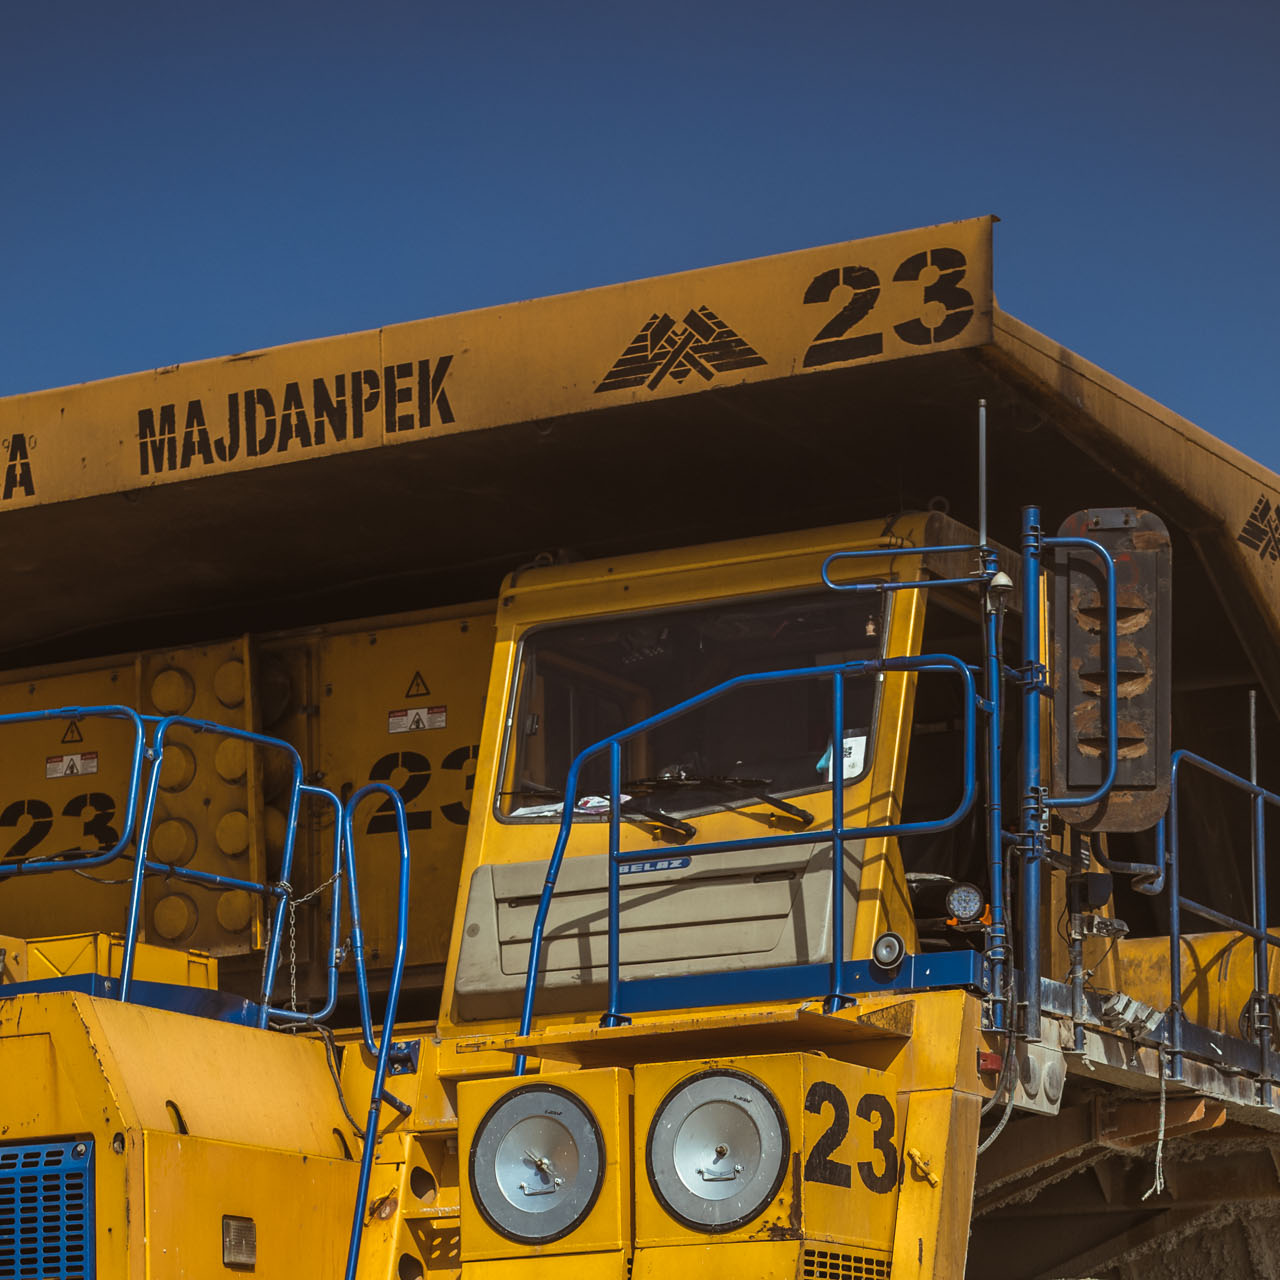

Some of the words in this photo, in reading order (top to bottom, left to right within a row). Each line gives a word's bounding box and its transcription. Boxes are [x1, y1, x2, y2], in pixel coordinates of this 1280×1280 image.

[802, 247, 975, 368] 23
[137, 355, 456, 476] MAJDANPEK
[619, 859, 683, 874] BELAZ
[803, 1081, 899, 1194] 23
